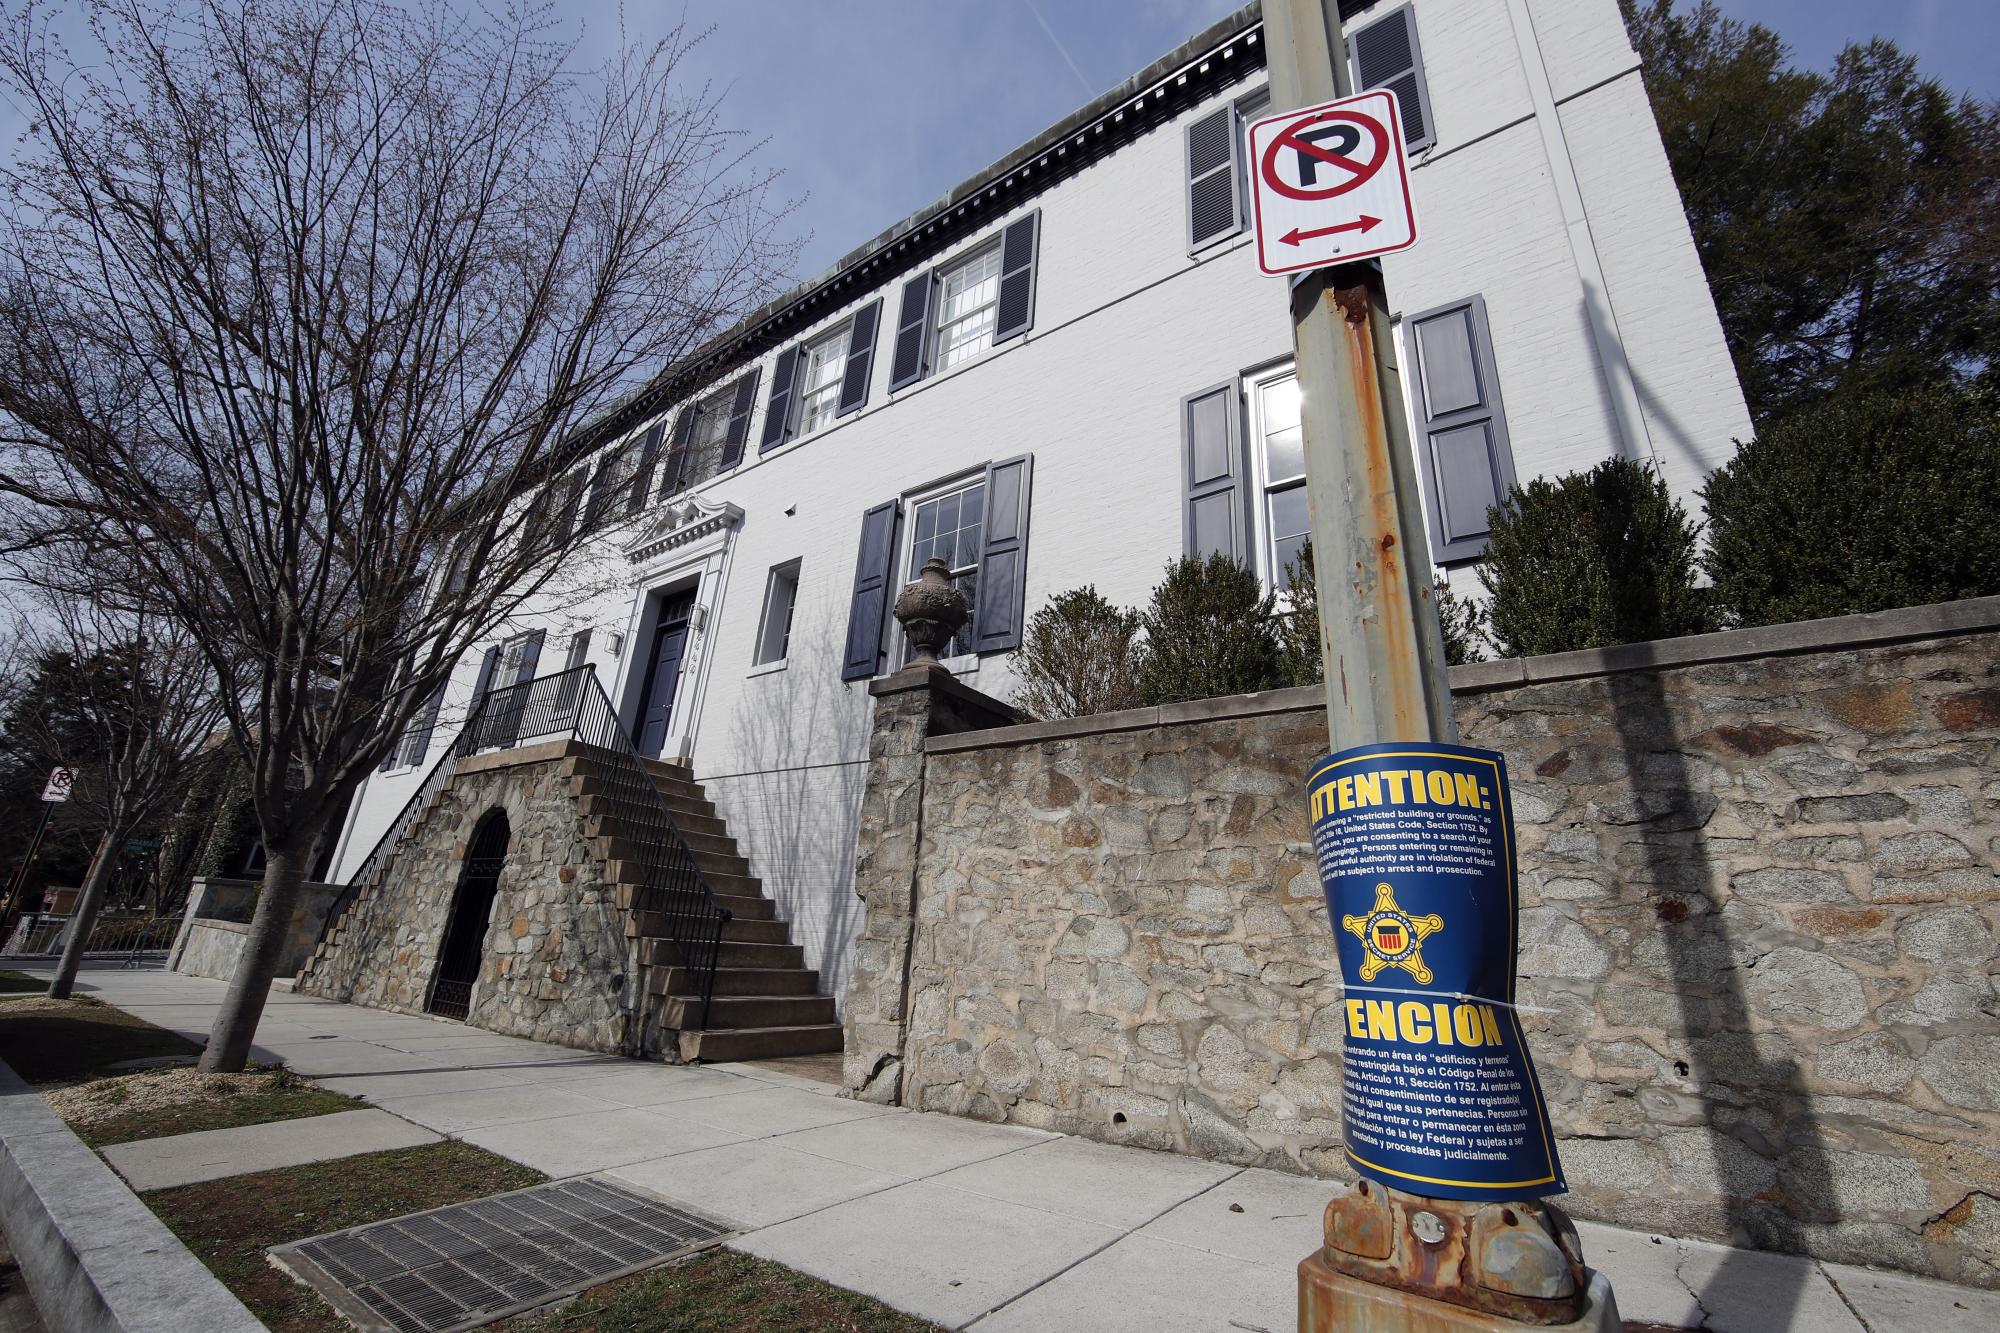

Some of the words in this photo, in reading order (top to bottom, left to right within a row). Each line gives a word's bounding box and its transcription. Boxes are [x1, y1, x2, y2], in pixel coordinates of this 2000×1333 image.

[1295, 125, 1360, 187] P
[1310, 770, 1491, 826] ATTENTION:
[1327, 818, 1346, 828] entering
[1352, 810, 1396, 821] "restricted
[1398, 810, 1434, 820] building
[1344, 824, 1367, 834] United
[1368, 821, 1396, 830] States
[1398, 821, 1425, 829] Code,
[1426, 821, 1458, 830] Section
[1460, 823, 1478, 832] 1752.
[1480, 825, 1488, 835] By
[1343, 837, 1357, 846] you
[1370, 831, 1420, 841] consenting
[1440, 832, 1467, 842] search
[1477, 836, 1492, 845] your
[1329, 847, 1360, 858] belongings.
[1362, 843, 1397, 852] Persons
[1399, 842, 1437, 852] entering
[1450, 844, 1486, 857] remaining
[1338, 856, 1358, 866] lawful
[1359, 853, 1397, 863] authority
[1416, 853, 1425, 861] in
[1427, 853, 1464, 863] violation
[1465, 855, 1473, 863] of
[1474, 856, 1496, 867] federal
[1347, 866, 1375, 876] subject
[1387, 865, 1415, 873] arrest
[1416, 865, 1434, 873] and
[1436, 866, 1484, 877] prosecution.
[1366, 912, 1386, 933] UNITED
[1387, 912, 1414, 933] STATES
[1367, 938, 1391, 961] SECRET
[1393, 938, 1416, 961] SERVICE
[1348, 1046, 1376, 1057] entrando
[1378, 1050, 1390, 1058] un
[1391, 1050, 1412, 1061] área
[1415, 1052, 1427, 1062] de
[1478, 1058, 1483, 1067] y
[1358, 1059, 1401, 1073] restringida
[1403, 1064, 1424, 1076] bajo
[1427, 1066, 1436, 1076] el
[1438, 1067, 1475, 1080] Código
[1476, 1069, 1498, 1078] Penal
[1498, 1069, 1505, 1078] de
[1363, 1084, 1369, 1093] el
[1370, 1087, 1441, 1103] consentimiento
[1444, 1094, 1457, 1104] de
[1459, 1096, 1475, 1105] ser
[1394, 1076, 1408, 1087] 18,
[1410, 1077, 1451, 1090] Sección
[1454, 1081, 1479, 1092] 1752.
[1480, 1082, 1490, 1092] Al
[1490, 1082, 1510, 1091] entrar
[1365, 1096, 1384, 1109] igual
[1385, 1102, 1402, 1112] que
[1404, 1105, 1423, 1114] sus
[1425, 1106, 1486, 1119] pertenecias.
[1487, 1109, 1519, 1119] Personas
[1366, 1110, 1382, 1121] para
[1383, 1114, 1410, 1125] entrar
[1412, 1119, 1419, 1127] o
[1421, 1118, 1482, 1132] permanecer
[1483, 1124, 1494, 1132] en
[1496, 1122, 1512, 1132] ésta
[1385, 1128, 1396, 1137] de
[1398, 1128, 1407, 1138] la
[1409, 1130, 1424, 1144] ley
[1426, 1132, 1466, 1146] Federal
[1467, 1138, 1474, 1148] y
[1476, 1137, 1507, 1149] sujetas
[1508, 1138, 1513, 1146] a
[1379, 1139, 1384, 1149] y
[1386, 1141, 1442, 1157] procesadas
[1444, 1148, 1510, 1160] judicialmente.
